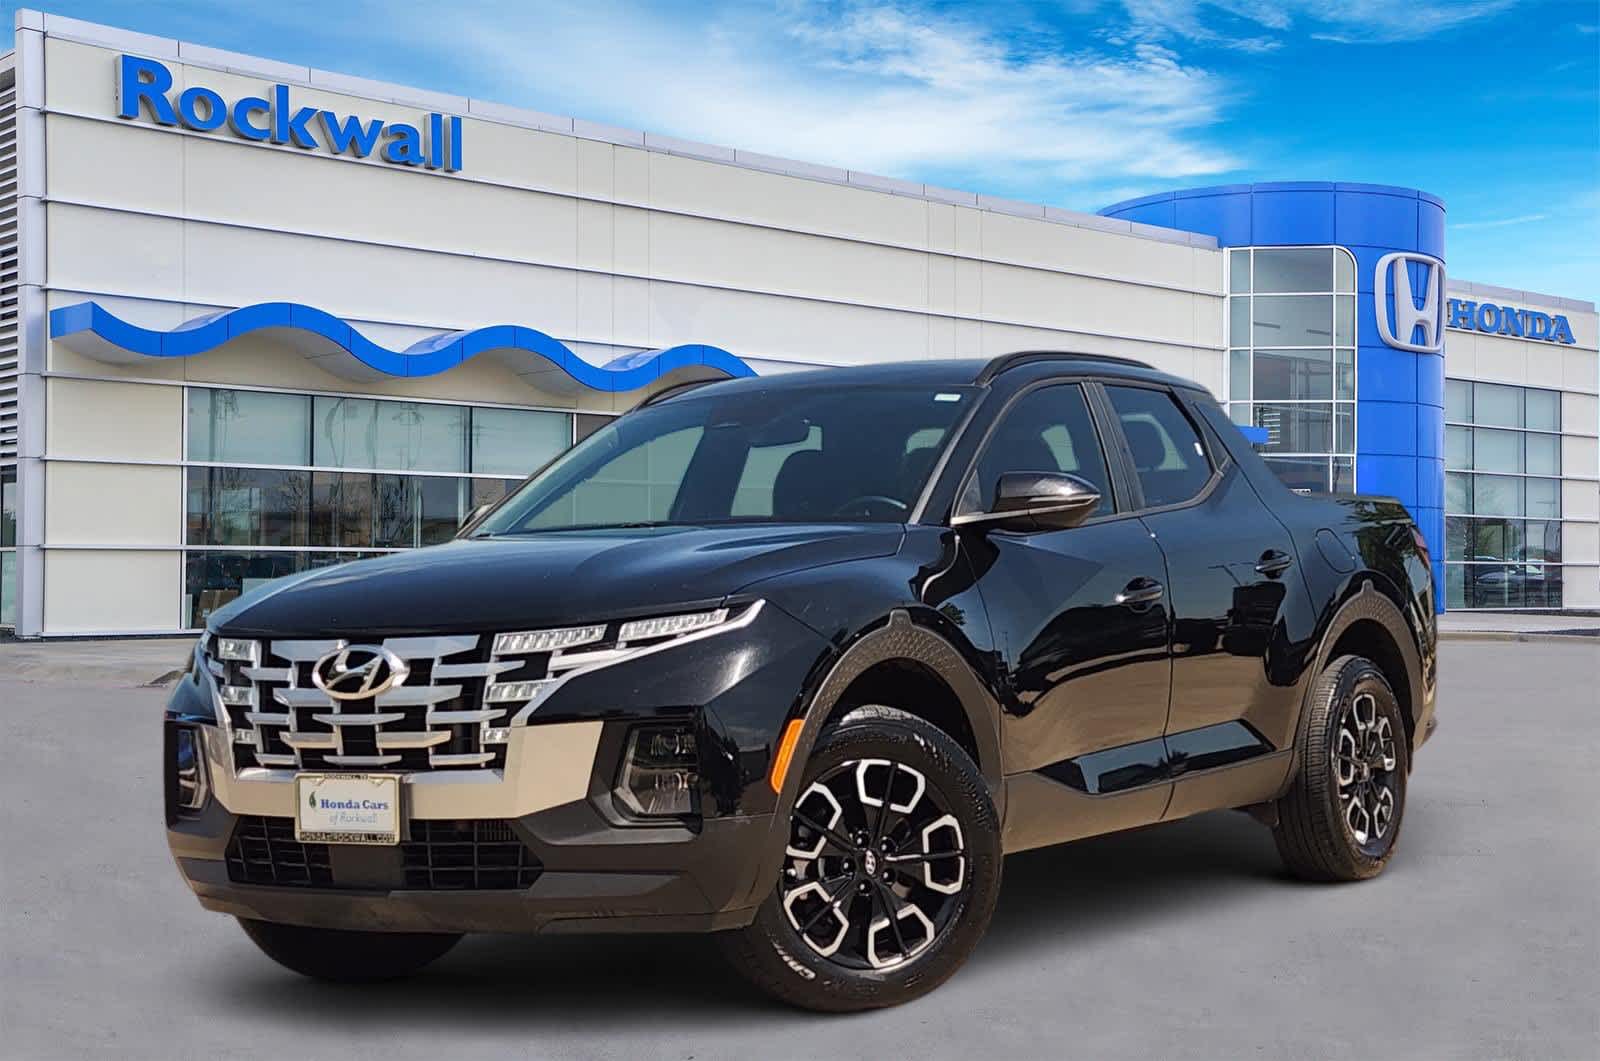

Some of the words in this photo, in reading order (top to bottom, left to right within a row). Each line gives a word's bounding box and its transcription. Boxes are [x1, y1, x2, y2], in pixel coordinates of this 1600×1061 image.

[115, 54, 463, 172] Rockwall
[1448, 298, 1577, 344] HONDA
[320, 799, 360, 810] Honda
[362, 800, 389, 810] Cars
[340, 811, 377, 824] Rockwall
